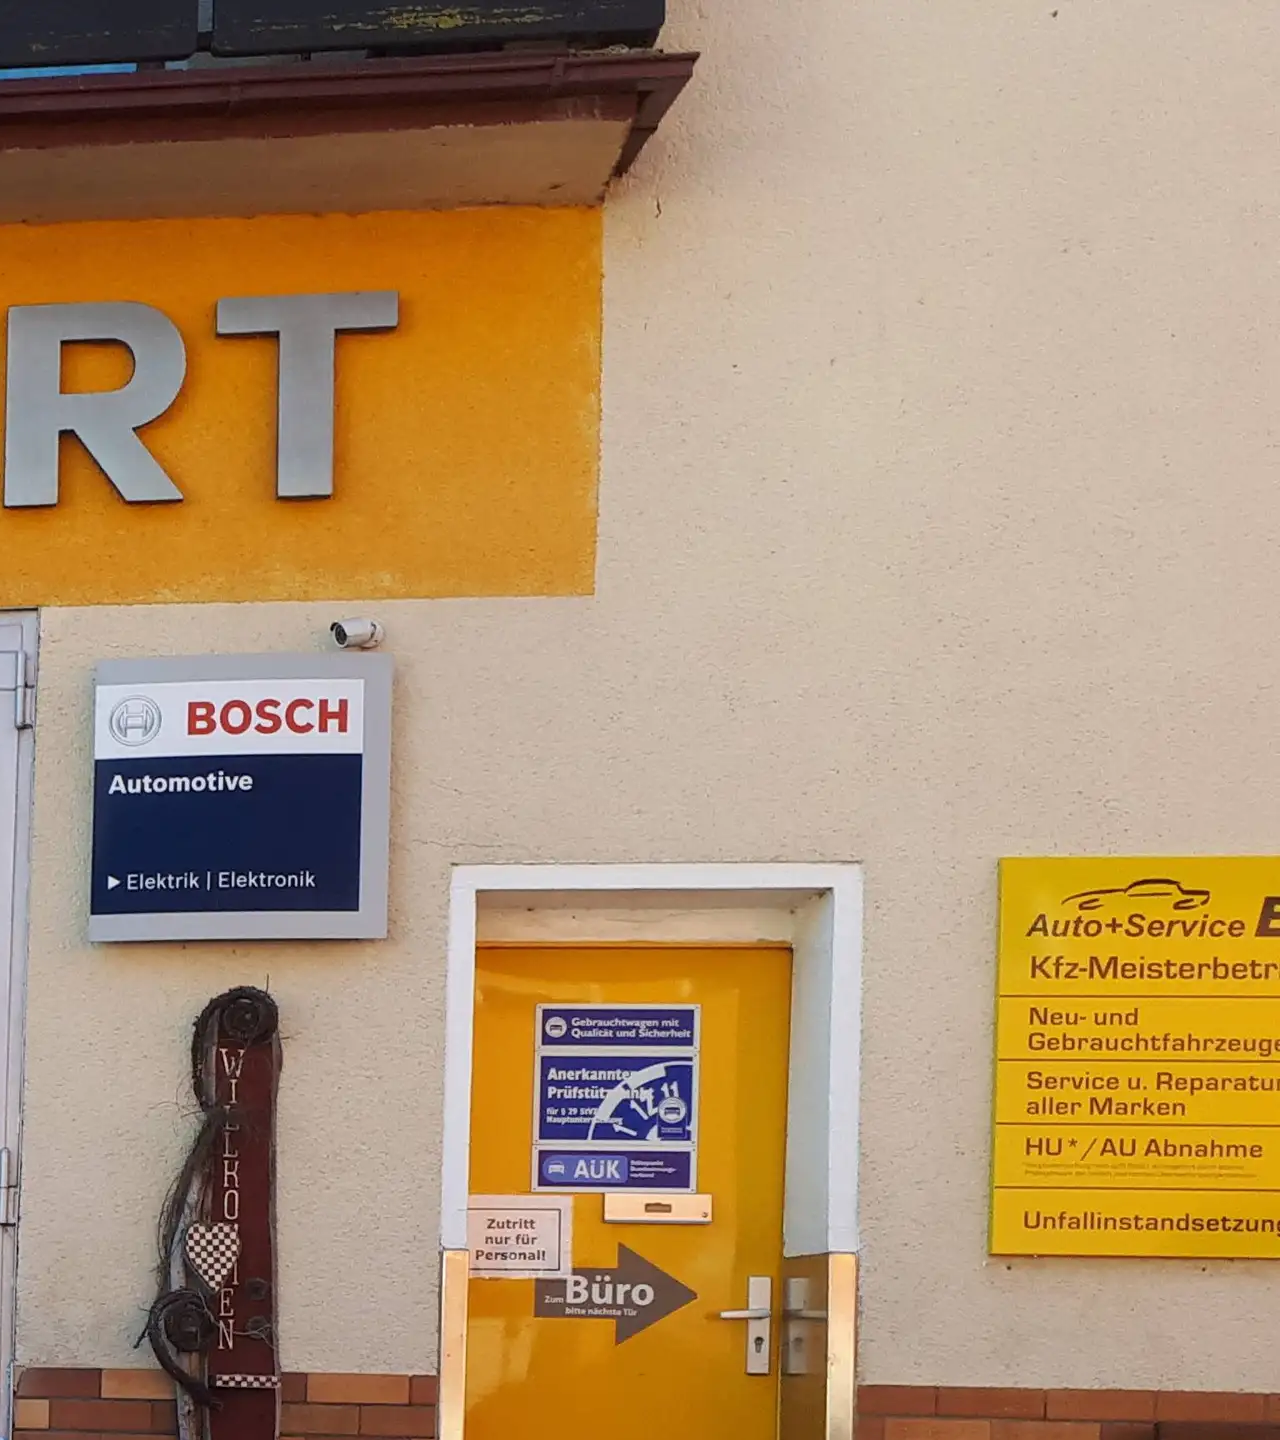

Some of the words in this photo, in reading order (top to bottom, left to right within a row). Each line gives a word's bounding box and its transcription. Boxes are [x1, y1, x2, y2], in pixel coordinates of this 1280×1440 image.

[187, 698, 348, 736] BOSCH
[108, 771, 253, 794] Automotive
[127, 872, 199, 890] Elektrik
[218, 871, 316, 888] Elektronik
[1026, 913, 1246, 937] Auto+Service
[1030, 955, 1280, 980] Kfz-Meisterbetr
[571, 1017, 659, 1028] Gebrauchtwagen
[661, 1018, 679, 1027] mit
[1029, 1007, 1087, 1025] Neu-
[1094, 1008, 1139, 1025] und
[571, 1028, 613, 1038] Qualität
[616, 1029, 636, 1038] und
[638, 1029, 691, 1038] Sicherheit
[1026, 1071, 1120, 1090] Service
[1127, 1075, 1147, 1090] u.
[1026, 1097, 1082, 1116] aller
[1089, 1097, 1186, 1116] Marken
[1144, 1138, 1263, 1158] Abnahme
[573, 1159, 621, 1180] AÜK
[218, 1048, 245, 1350] WILLKOEN
[486, 1218, 536, 1230] Zutritt
[1023, 1211, 1280, 1237] Unfallinstandsetzun
[485, 1235, 511, 1245] nur
[515, 1233, 538, 1245] für
[475, 1250, 546, 1261] Personal!
[544, 1295, 564, 1304] Zum
[565, 1275, 654, 1306] Büro
[565, 1306, 585, 1315] bitte
[587, 1307, 622, 1316] nächste
[623, 1308, 638, 1316] Tür
